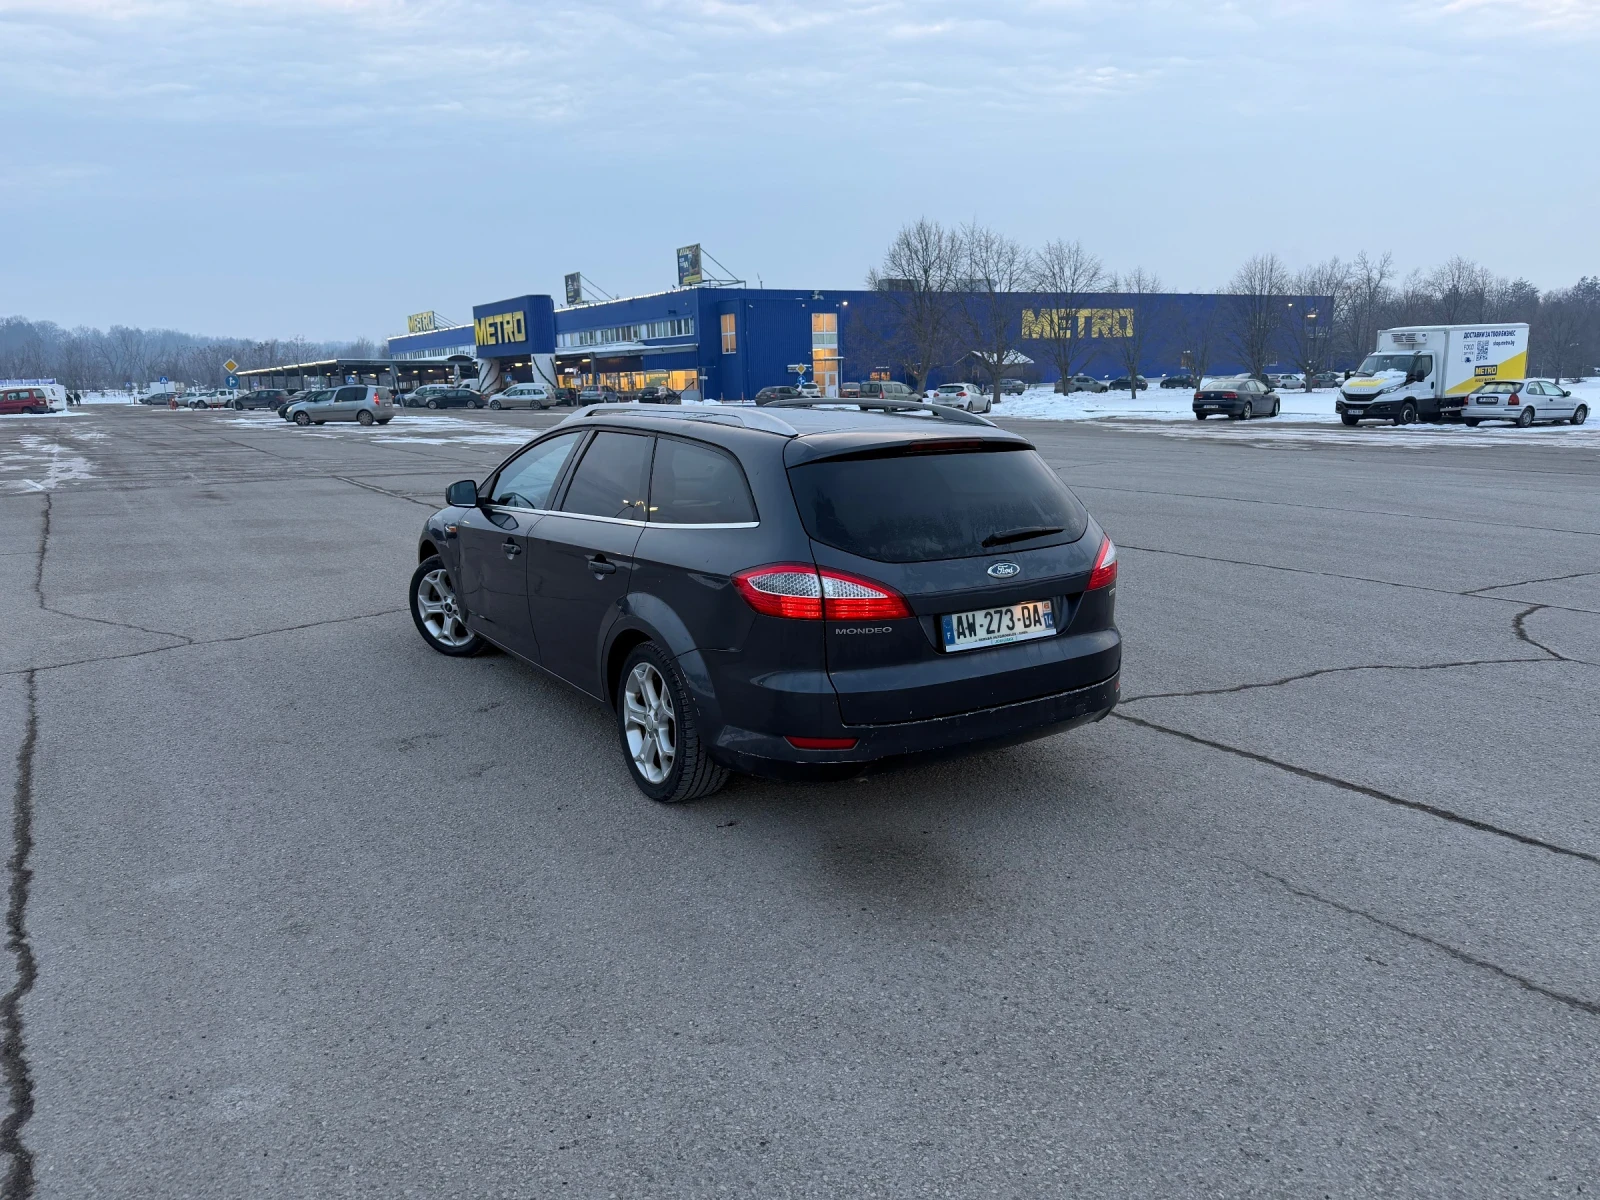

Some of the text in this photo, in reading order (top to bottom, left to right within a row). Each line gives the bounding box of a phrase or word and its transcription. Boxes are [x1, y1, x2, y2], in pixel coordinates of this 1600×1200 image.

[407, 311, 435, 333] METRO
[1021, 308, 1134, 339] METRO
[474, 311, 526, 346] METRO
[1463, 331, 1485, 339] ДОСТАВКИ
[1501, 329, 1516, 337] БИЗНЕС
[1475, 366, 1497, 375] METRO
[996, 564, 1014, 575] Ford
[956, 604, 1043, 640] AW-273-DA
[1044, 614, 1054, 626] 14
[835, 626, 893, 635] MONDEO
[946, 631, 952, 640] F
